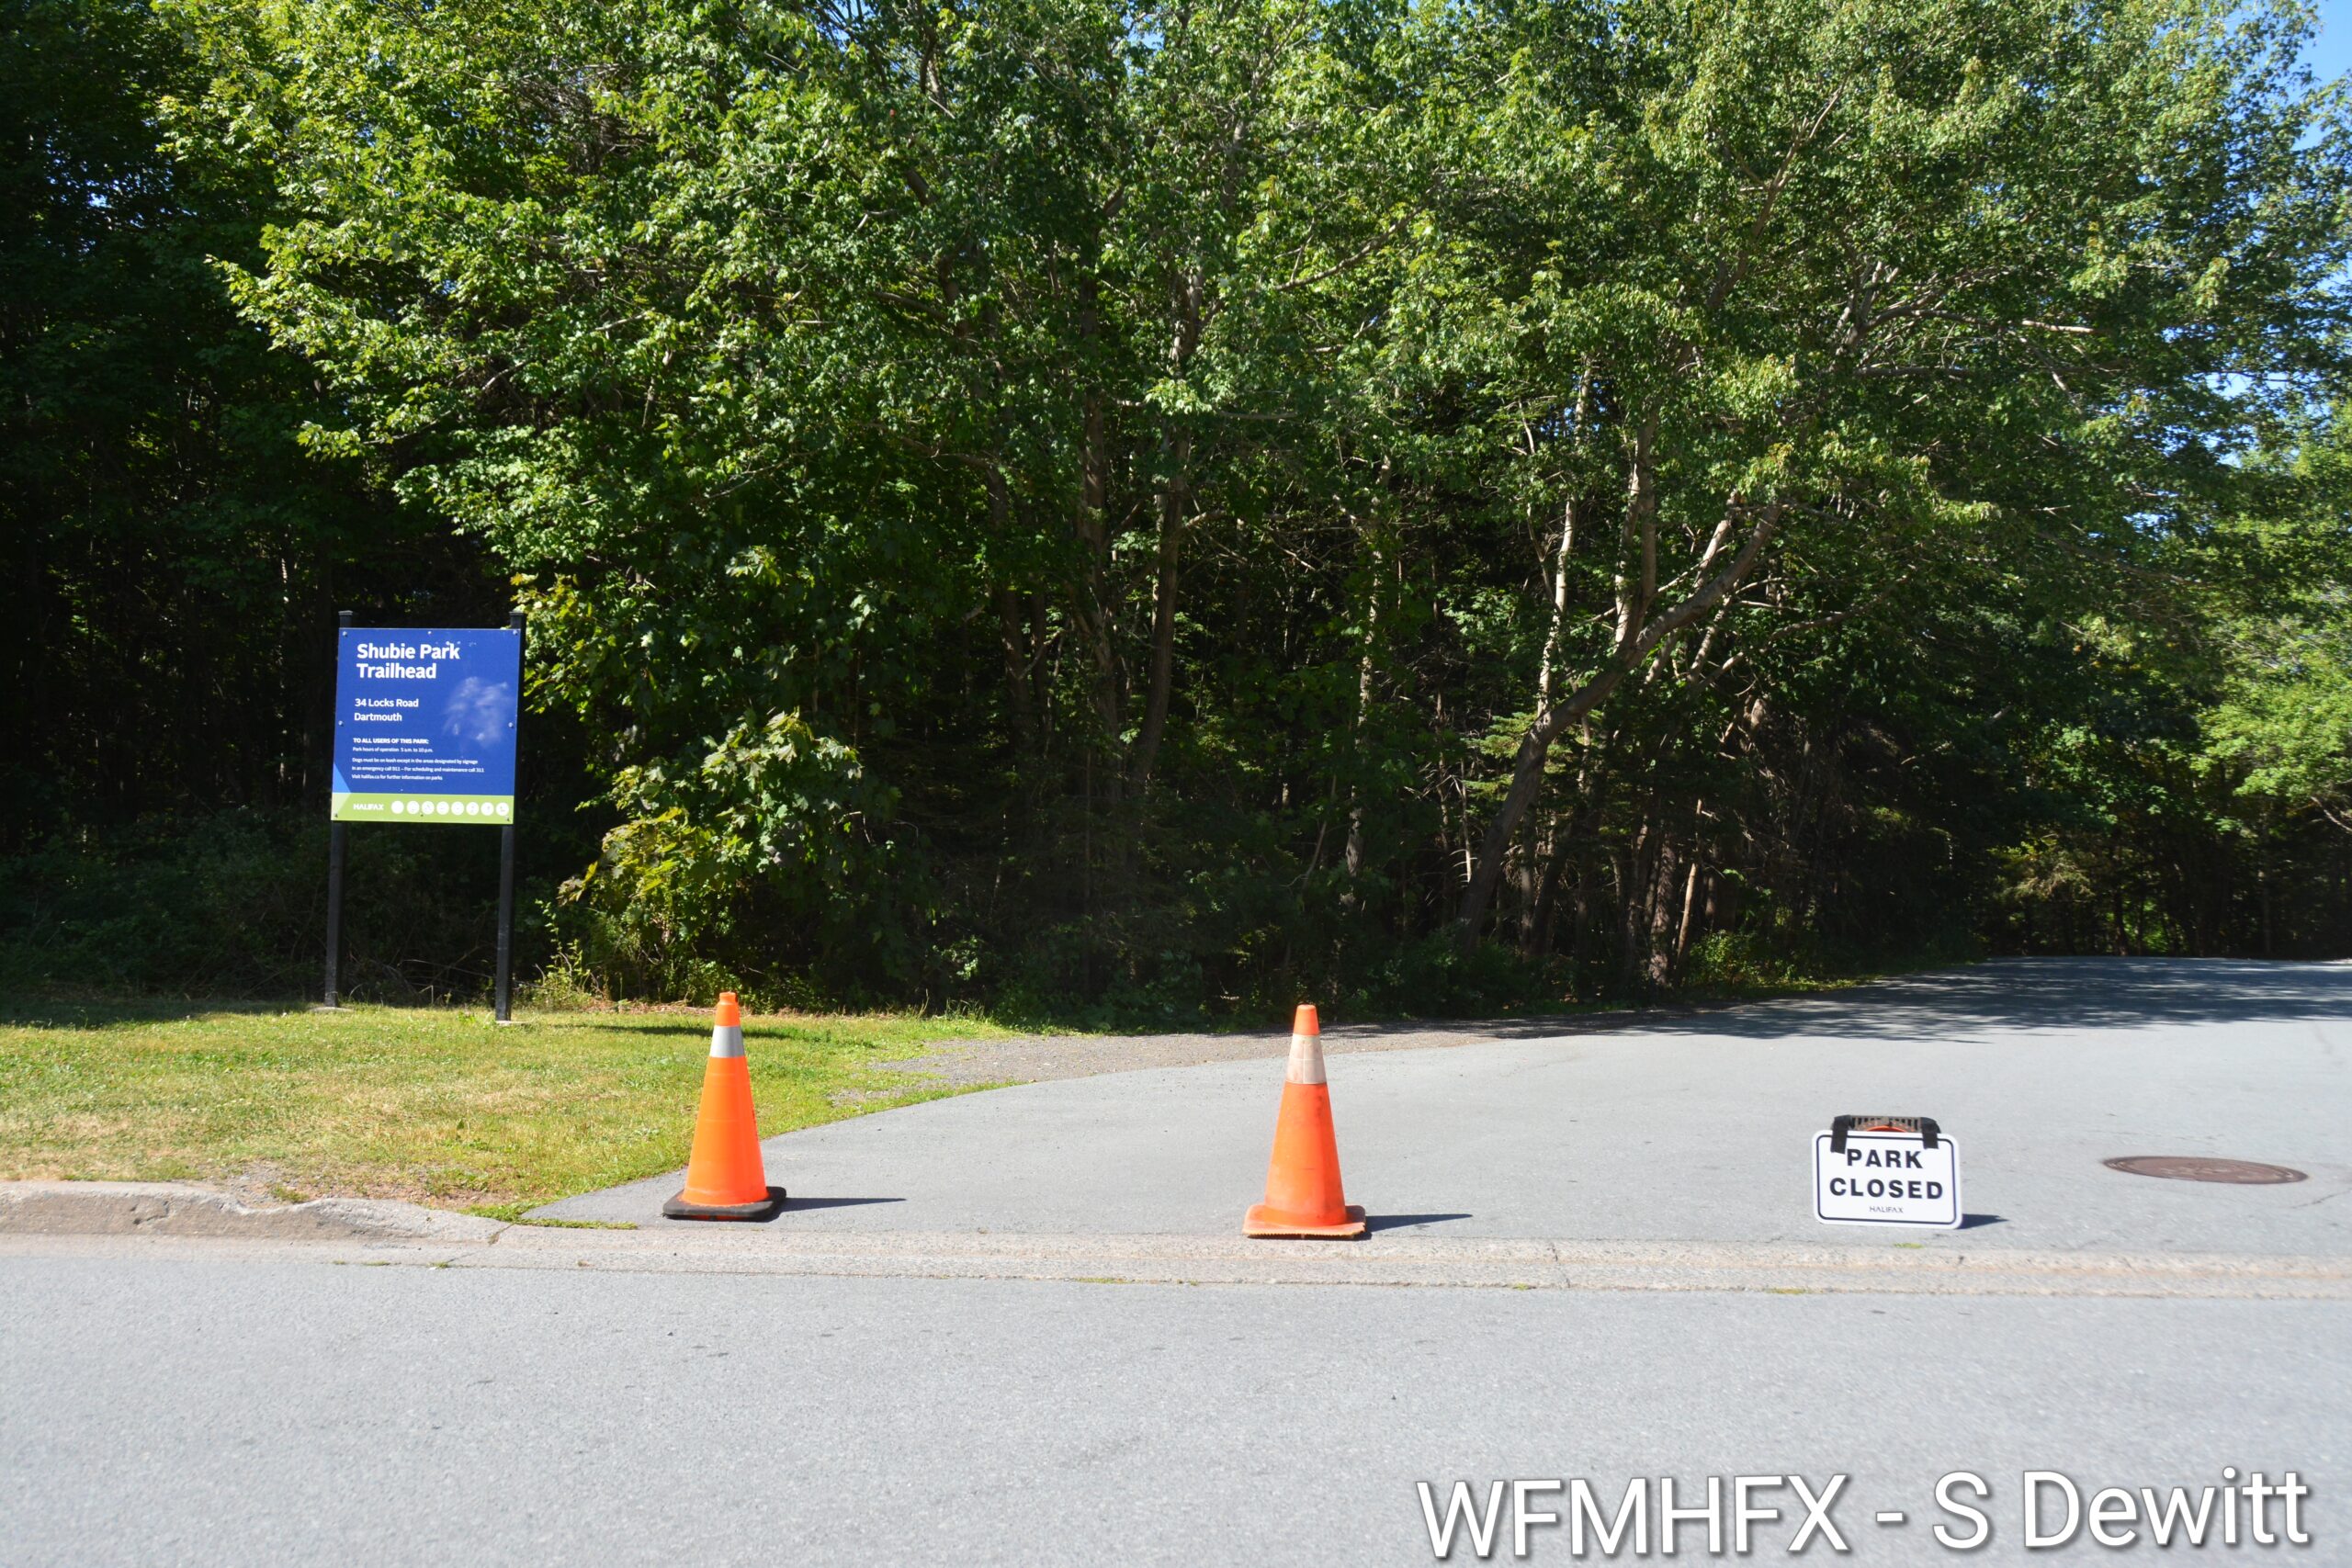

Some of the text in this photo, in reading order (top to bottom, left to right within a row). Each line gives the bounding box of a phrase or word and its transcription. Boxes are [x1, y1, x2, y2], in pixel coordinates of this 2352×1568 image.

[356, 643, 460, 660] Shubie Park
[356, 662, 436, 679] Trailhead
[355, 698, 419, 708] 34 Locks Road
[354, 712, 402, 722] Dartmouth
[1847, 1149, 1923, 1169] PARK
[1829, 1178, 1943, 1200] CLOSED
